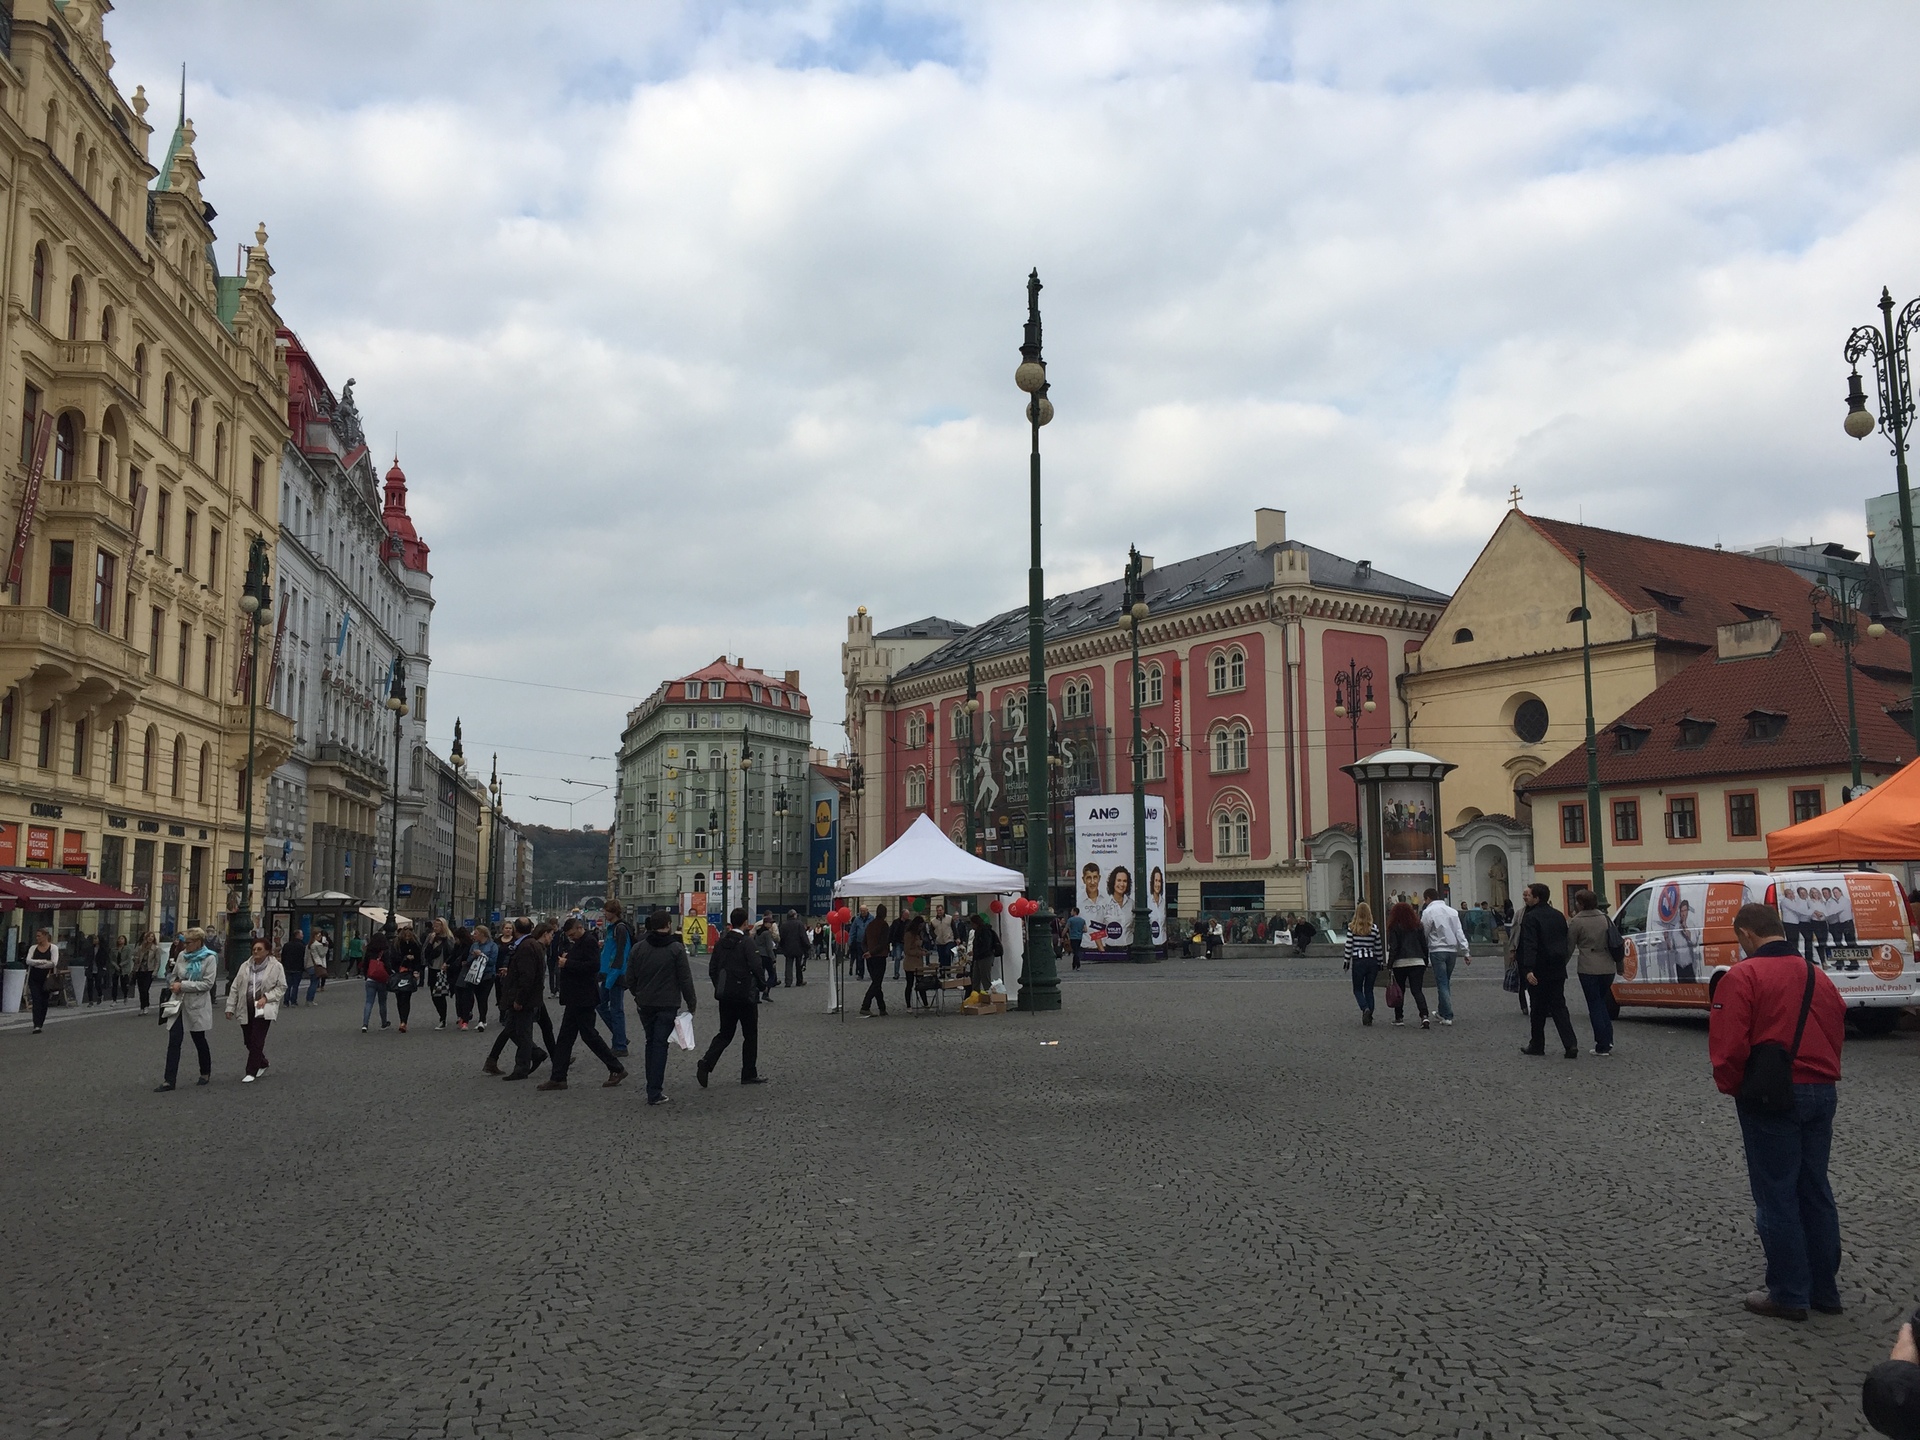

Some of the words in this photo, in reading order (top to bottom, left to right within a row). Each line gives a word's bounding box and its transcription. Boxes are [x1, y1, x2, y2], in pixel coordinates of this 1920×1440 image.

[19, 504, 33, 549] KINGS
[31, 456, 44, 500] COURT
[1011, 703, 1058, 742] 20
[1003, 738, 1074, 776] SHPS
[668, 748, 678, 844] HOTEL
[30, 803, 62, 819] CHANGE
[1088, 808, 1120, 820] ANO
[1145, 808, 1158, 820] NO
[30, 832, 48, 840] CHANGE
[28, 840, 48, 848] WECHSEL
[816, 878, 825, 888] 400
[1624, 939, 1631, 956] 8
[1833, 949, 1846, 957] 2SE
[1852, 949, 1869, 957] 1268
[1881, 945, 1892, 960] 8
